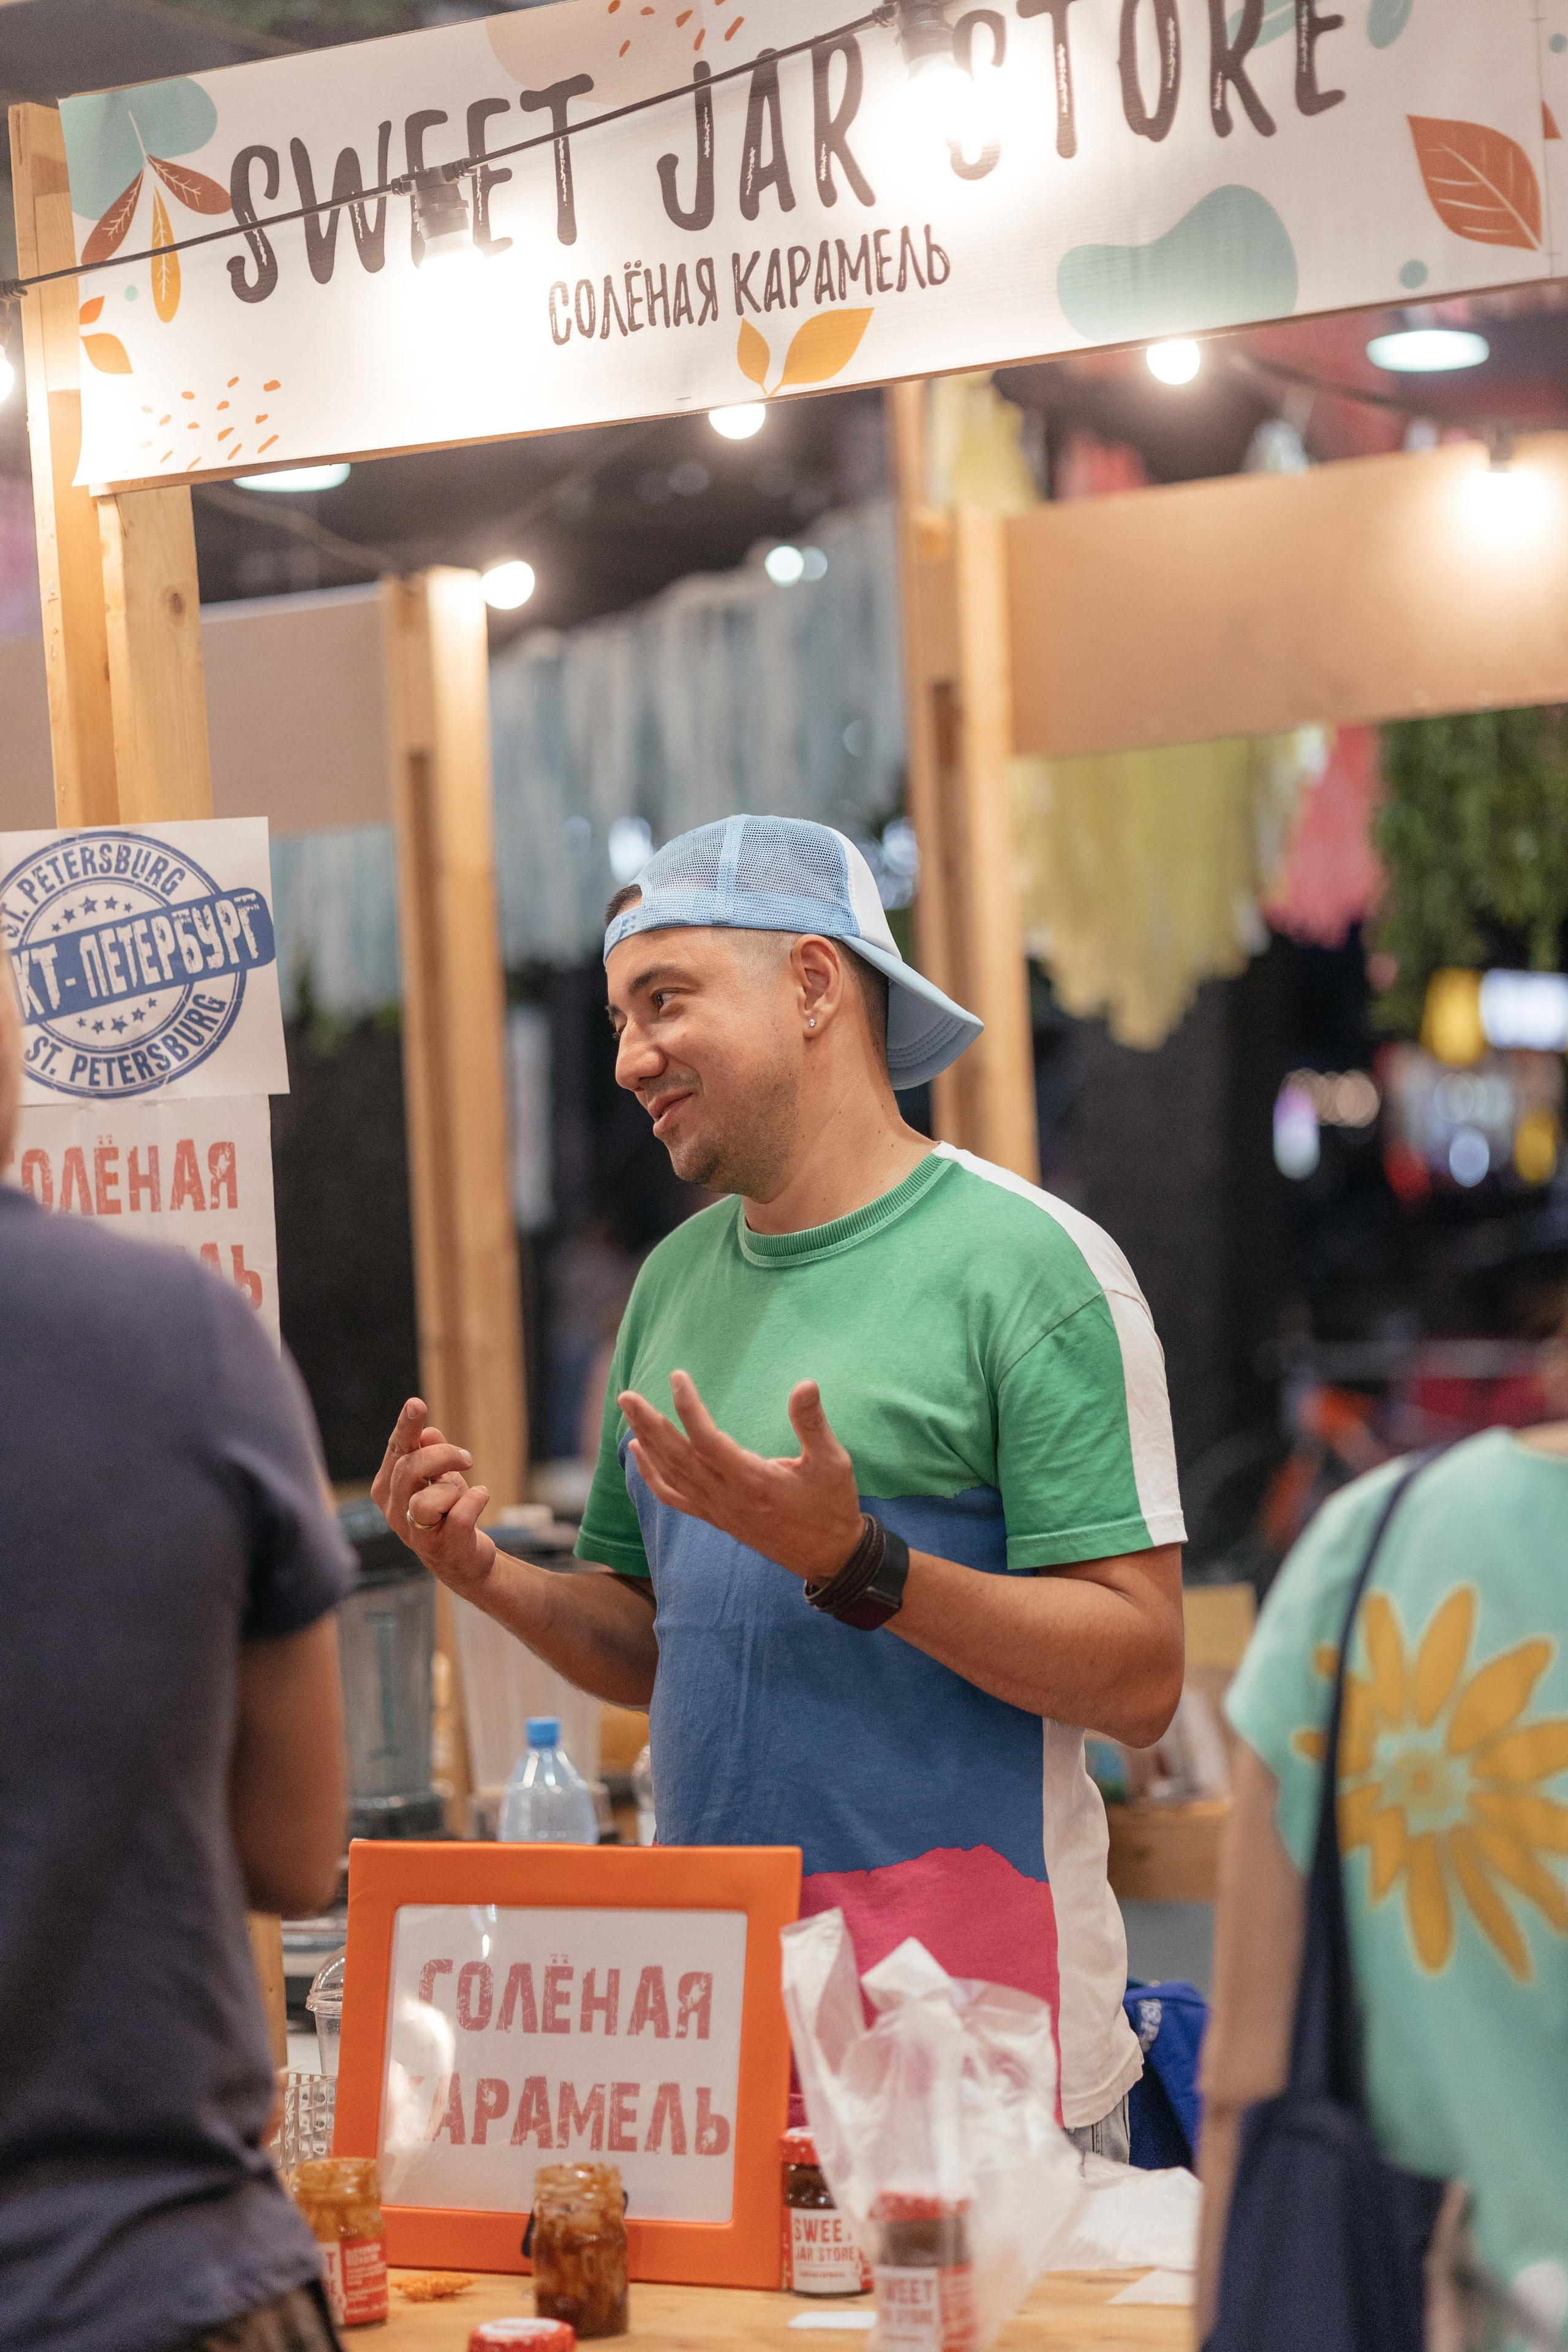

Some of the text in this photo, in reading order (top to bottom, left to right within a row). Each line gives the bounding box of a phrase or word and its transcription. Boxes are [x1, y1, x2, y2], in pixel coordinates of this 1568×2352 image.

[656, 30, 876, 232] JAR
[548, 224, 951, 345] СОЛЁНАЯ КАРАМЕЛЬ
[16, 843, 186, 905] PETERSBURG
[12, 892, 260, 1019] КТ-ПЕТЕРБУРГ
[24, 993, 227, 1087] ST. PETERSBURG
[21, 1134, 239, 1215] ОЛЁНАЯ
[409, 2073, 731, 2156] АРАМЕЛЬ
[794, 2218, 852, 2243] SWEE
